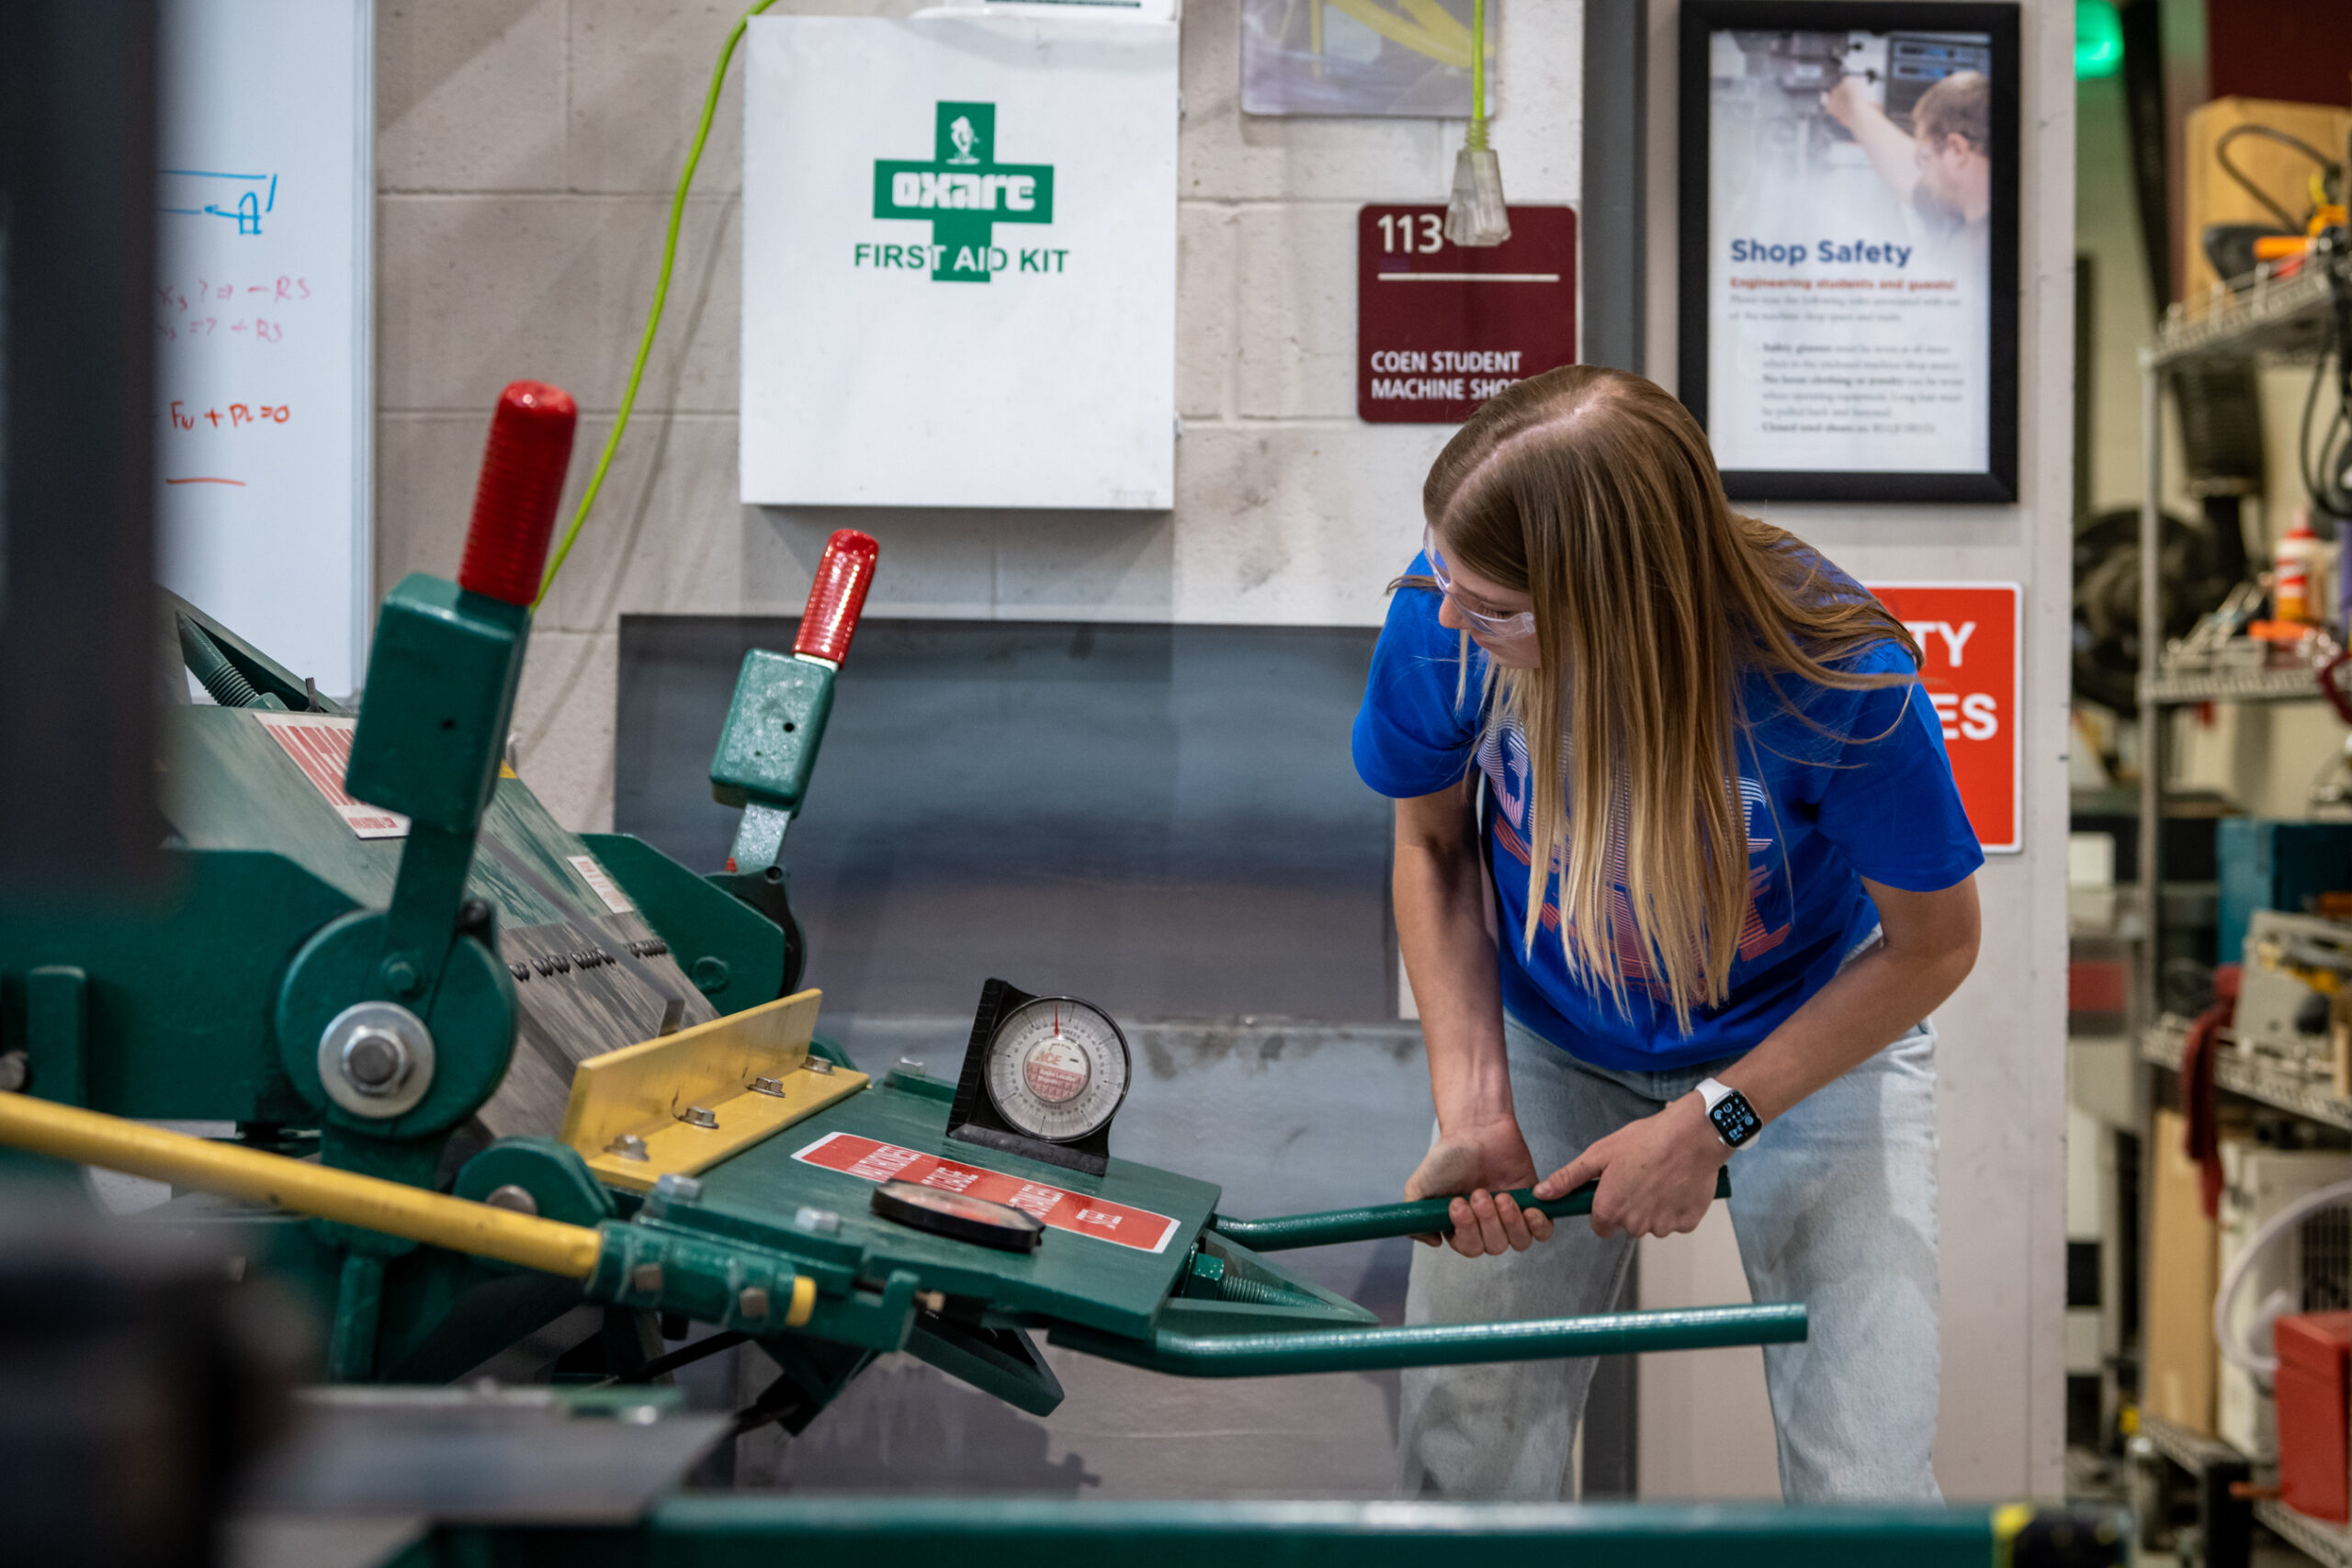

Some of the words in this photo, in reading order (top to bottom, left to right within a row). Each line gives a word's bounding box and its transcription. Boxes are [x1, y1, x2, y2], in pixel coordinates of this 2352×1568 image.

[1377, 213, 1444, 254] 113
[854, 243, 946, 272] FIRST
[953, 245, 1008, 273] AID
[1020, 248, 1069, 273] KIT
[1730, 239, 1807, 266] Shop
[1818, 240, 1912, 267] Safety
[1730, 277, 1812, 290] Engineering
[1816, 279, 1874, 290] students
[1880, 279, 1904, 290] and
[1371, 351, 1428, 373] COEN
[1431, 351, 1522, 373] STUDENT
[1371, 378, 1465, 400] MACHINE
[1470, 378, 1523, 400] SHO
[1902, 621, 1976, 668] TY
[1928, 693, 1998, 741] ES
